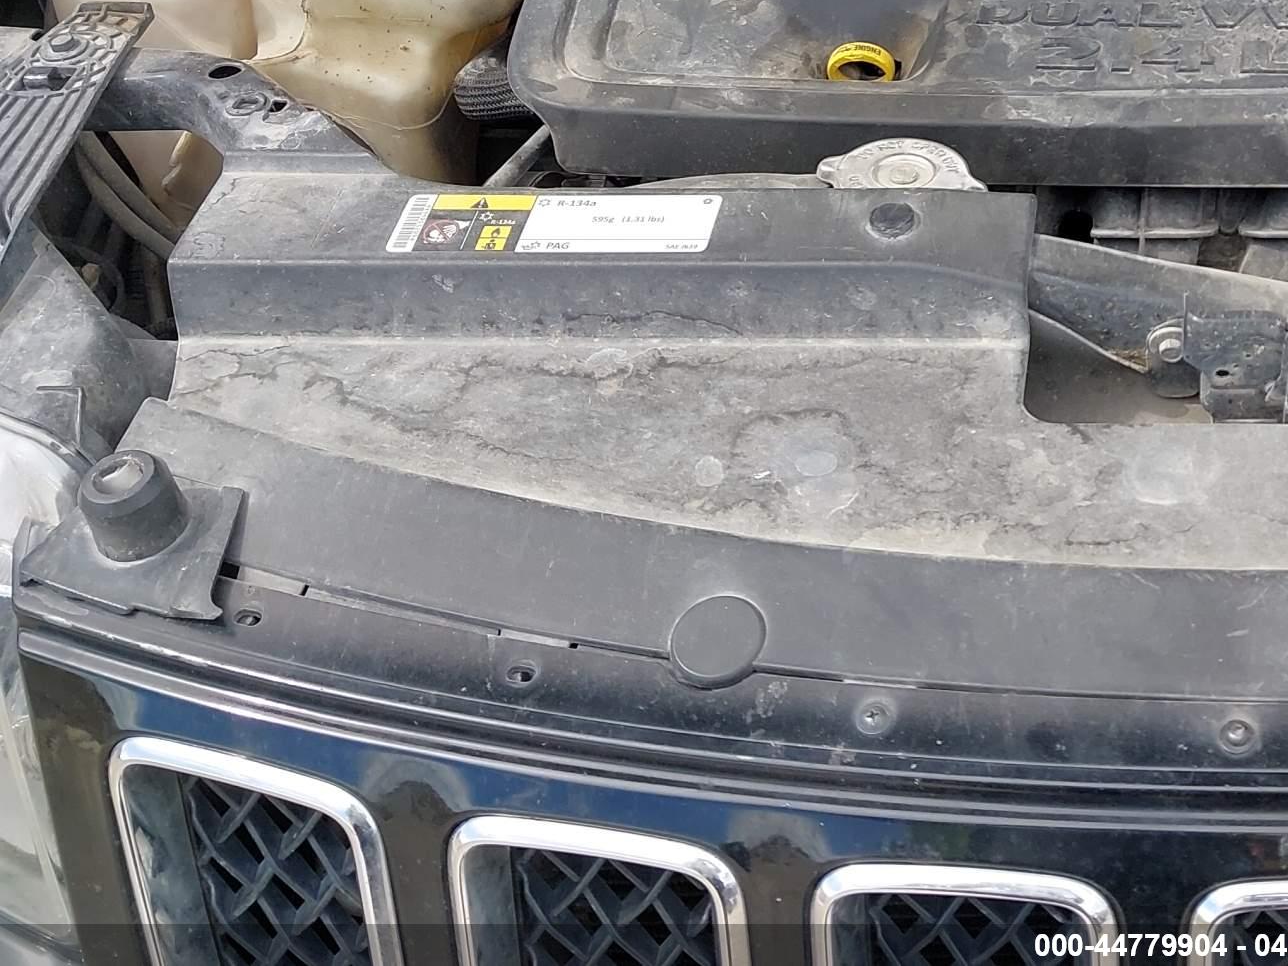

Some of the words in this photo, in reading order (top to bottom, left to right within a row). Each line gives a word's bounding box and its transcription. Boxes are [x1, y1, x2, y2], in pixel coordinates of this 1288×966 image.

[975, 2, 1183, 29] DUAL
[854, 44, 882, 56] ENGINE
[557, 199, 597, 207] R-134a
[592, 216, 615, 224] 595g
[546, 242, 570, 250] PAG
